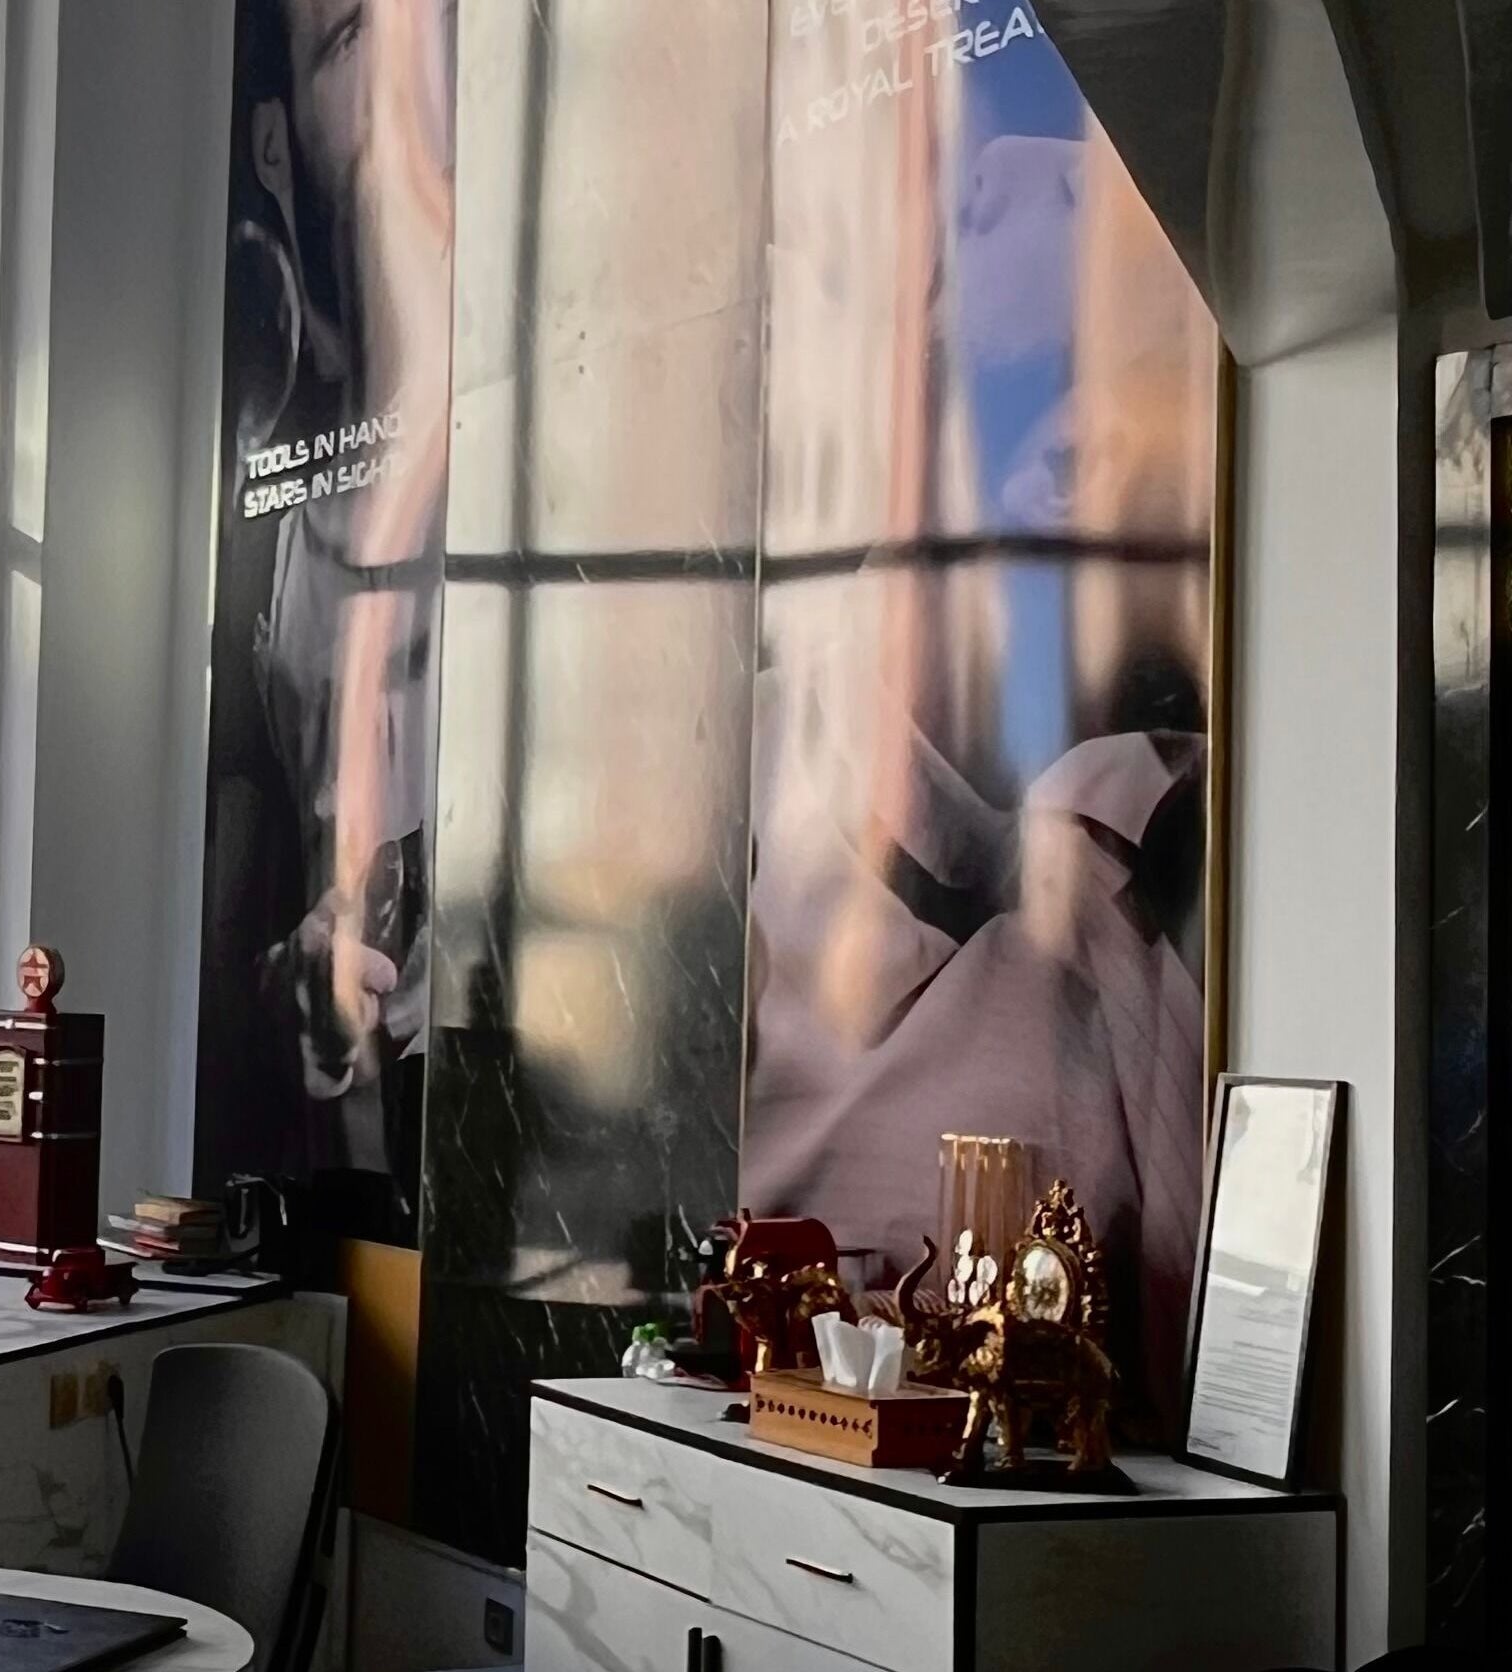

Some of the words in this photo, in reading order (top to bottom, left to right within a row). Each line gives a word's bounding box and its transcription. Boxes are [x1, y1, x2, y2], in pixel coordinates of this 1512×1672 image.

[807, 59, 913, 134] ROYAL
[924, 6, 1044, 76] TREA
[245, 440, 309, 479] TOOLS
[314, 431, 335, 460] IN
[339, 413, 401, 454] HAND
[244, 479, 308, 518] STARS
[312, 470, 333, 499] IN
